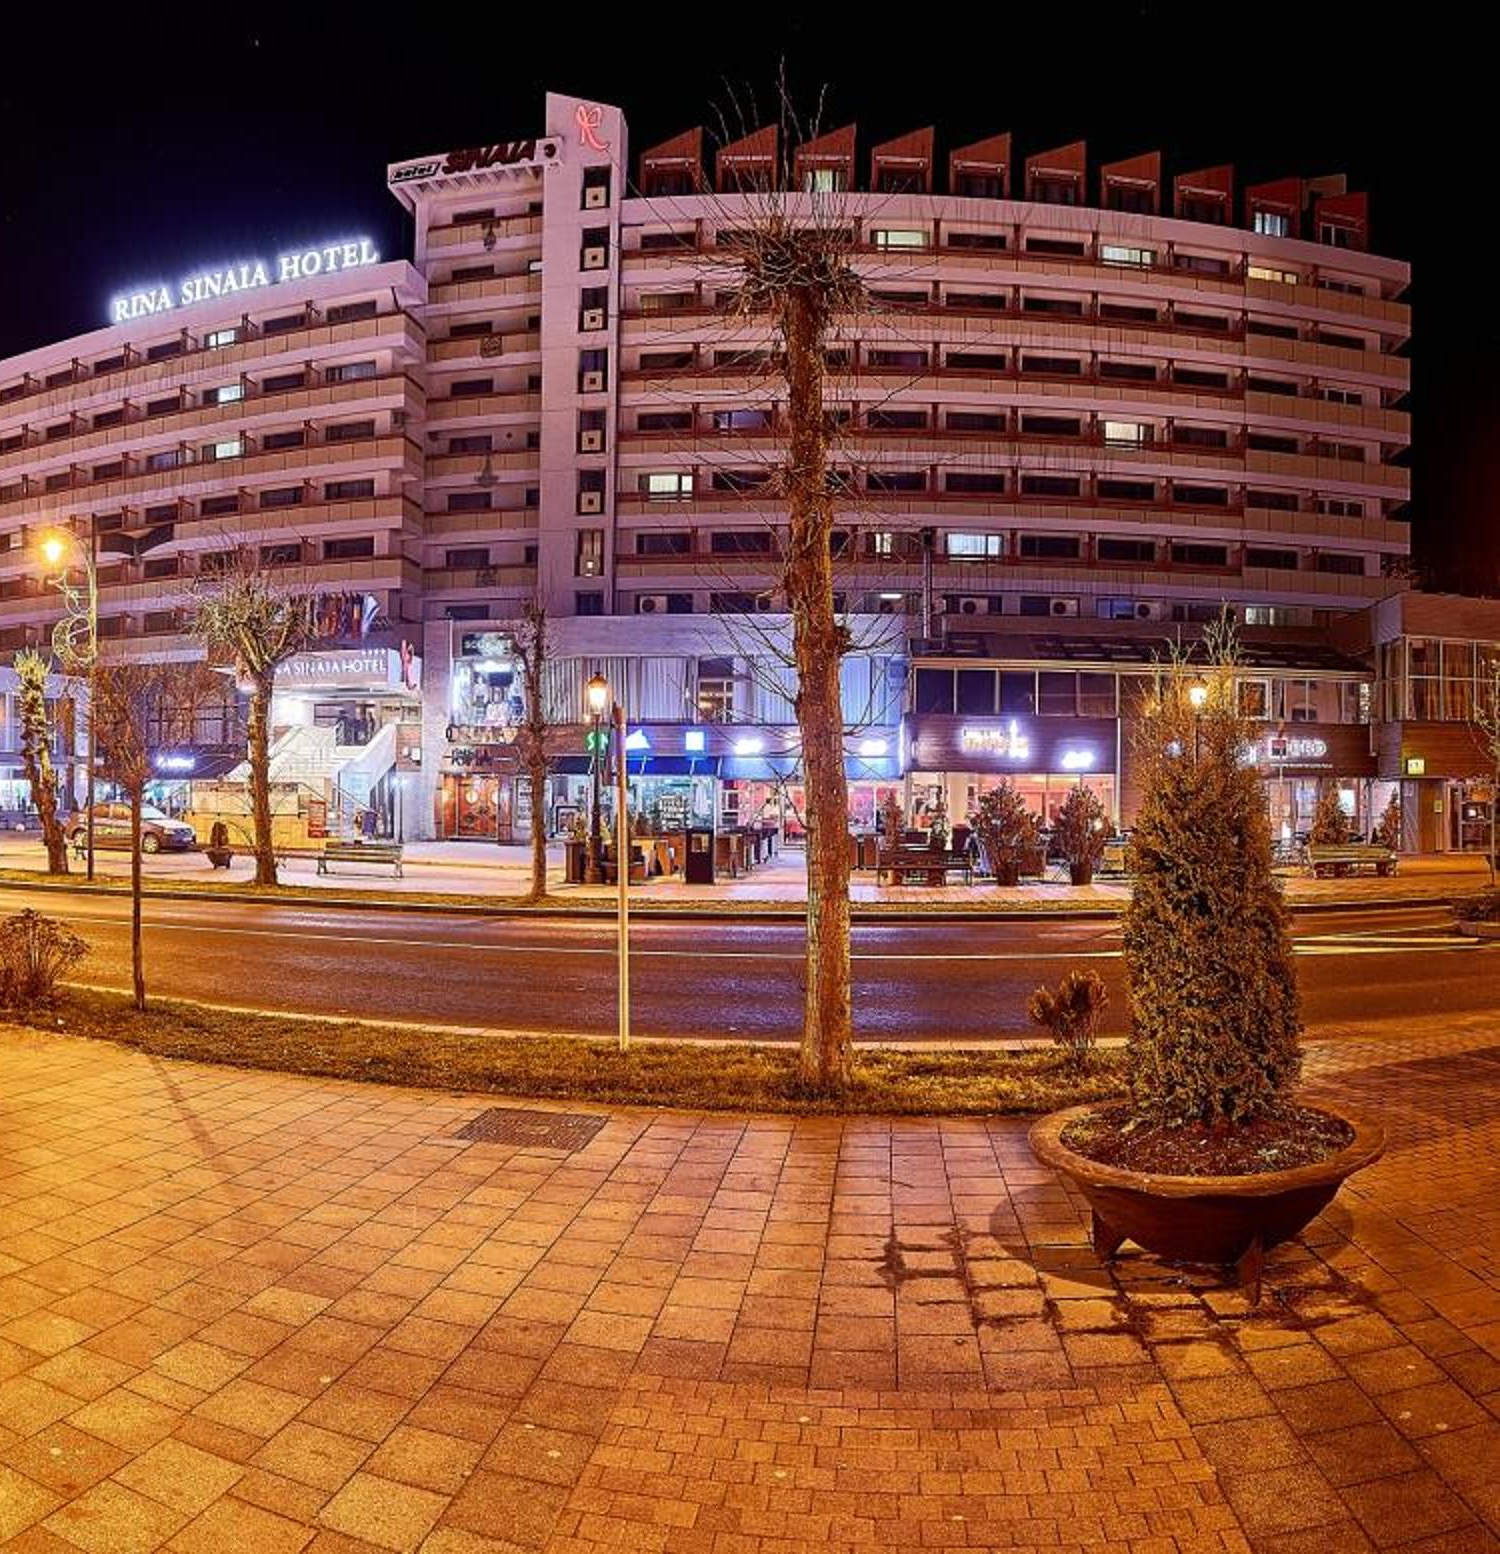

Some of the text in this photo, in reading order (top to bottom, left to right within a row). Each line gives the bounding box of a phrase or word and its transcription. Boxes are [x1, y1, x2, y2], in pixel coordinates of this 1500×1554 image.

[114, 238, 378, 321] RINA SINAIA HOTEL
[294, 660, 340, 674] SINAIA
[342, 658, 387, 673] HOTEL
